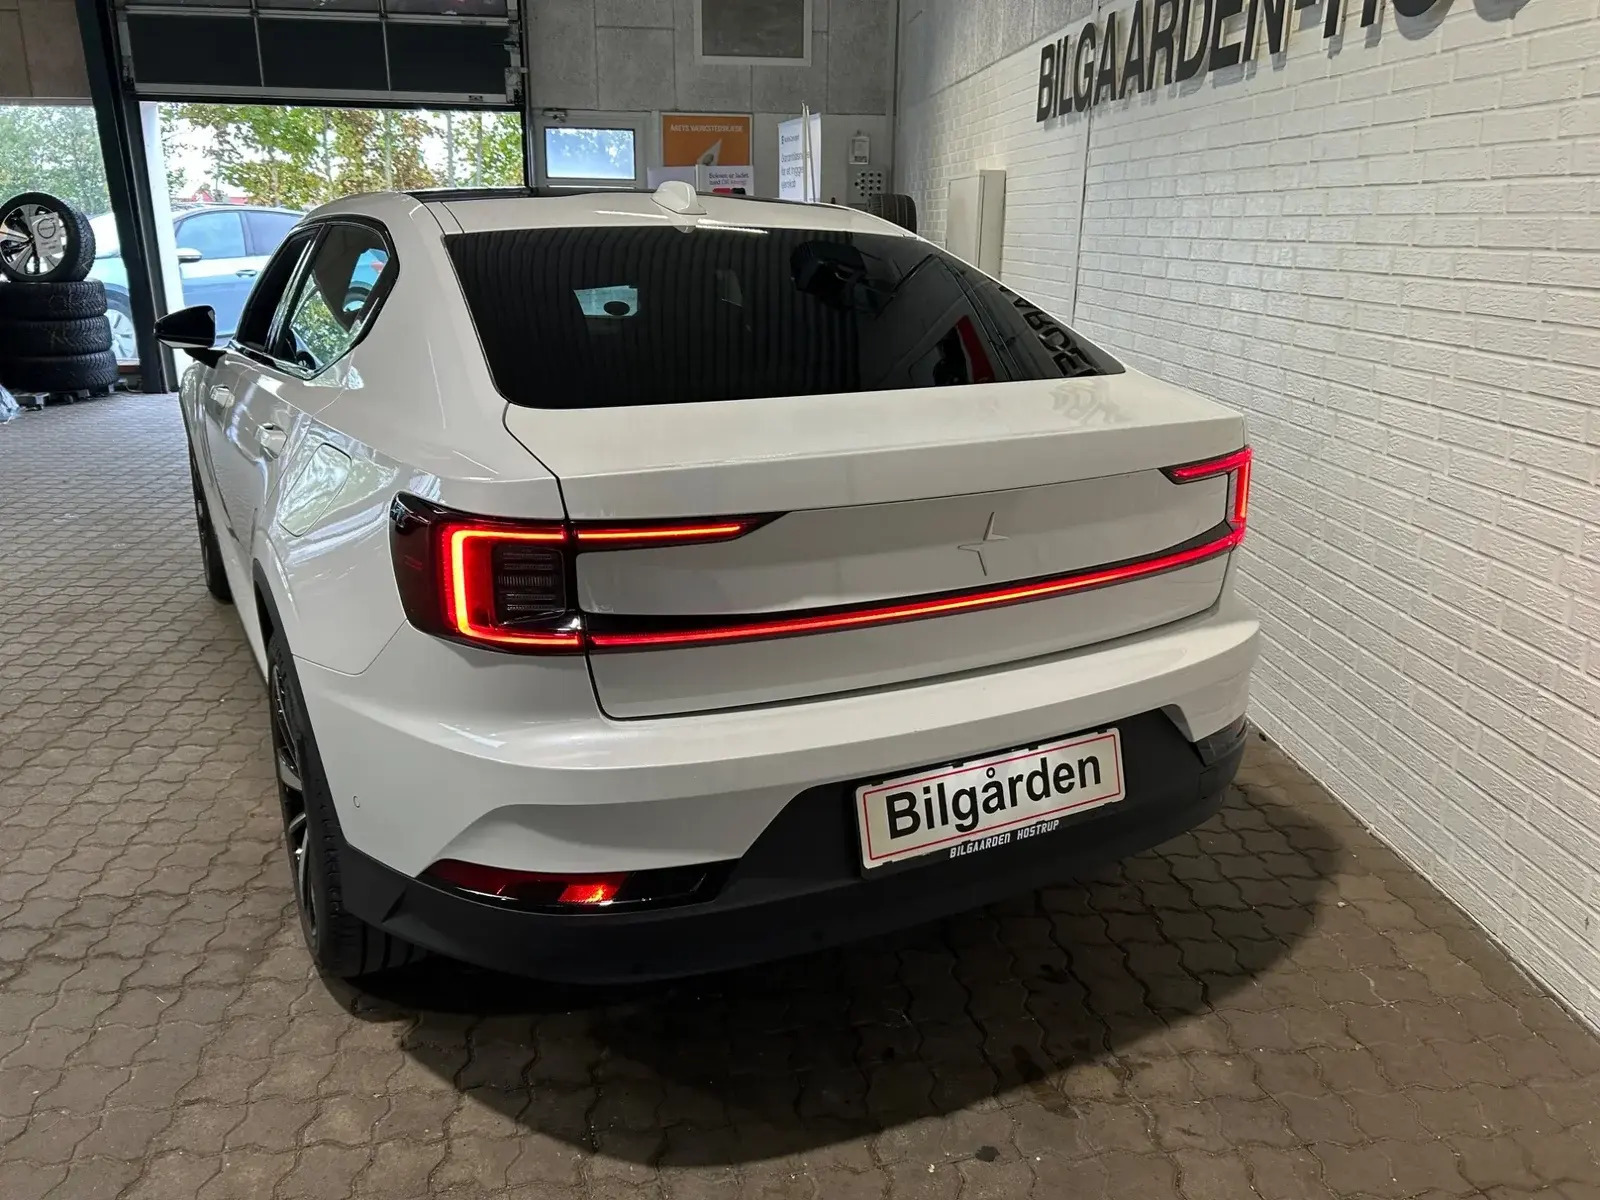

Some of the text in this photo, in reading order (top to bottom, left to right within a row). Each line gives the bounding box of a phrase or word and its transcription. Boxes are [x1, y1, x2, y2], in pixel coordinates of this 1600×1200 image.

[885, 755, 1101, 839] Bilgården
[949, 820, 1059, 858] BILGAARDEN HOSTRUP
